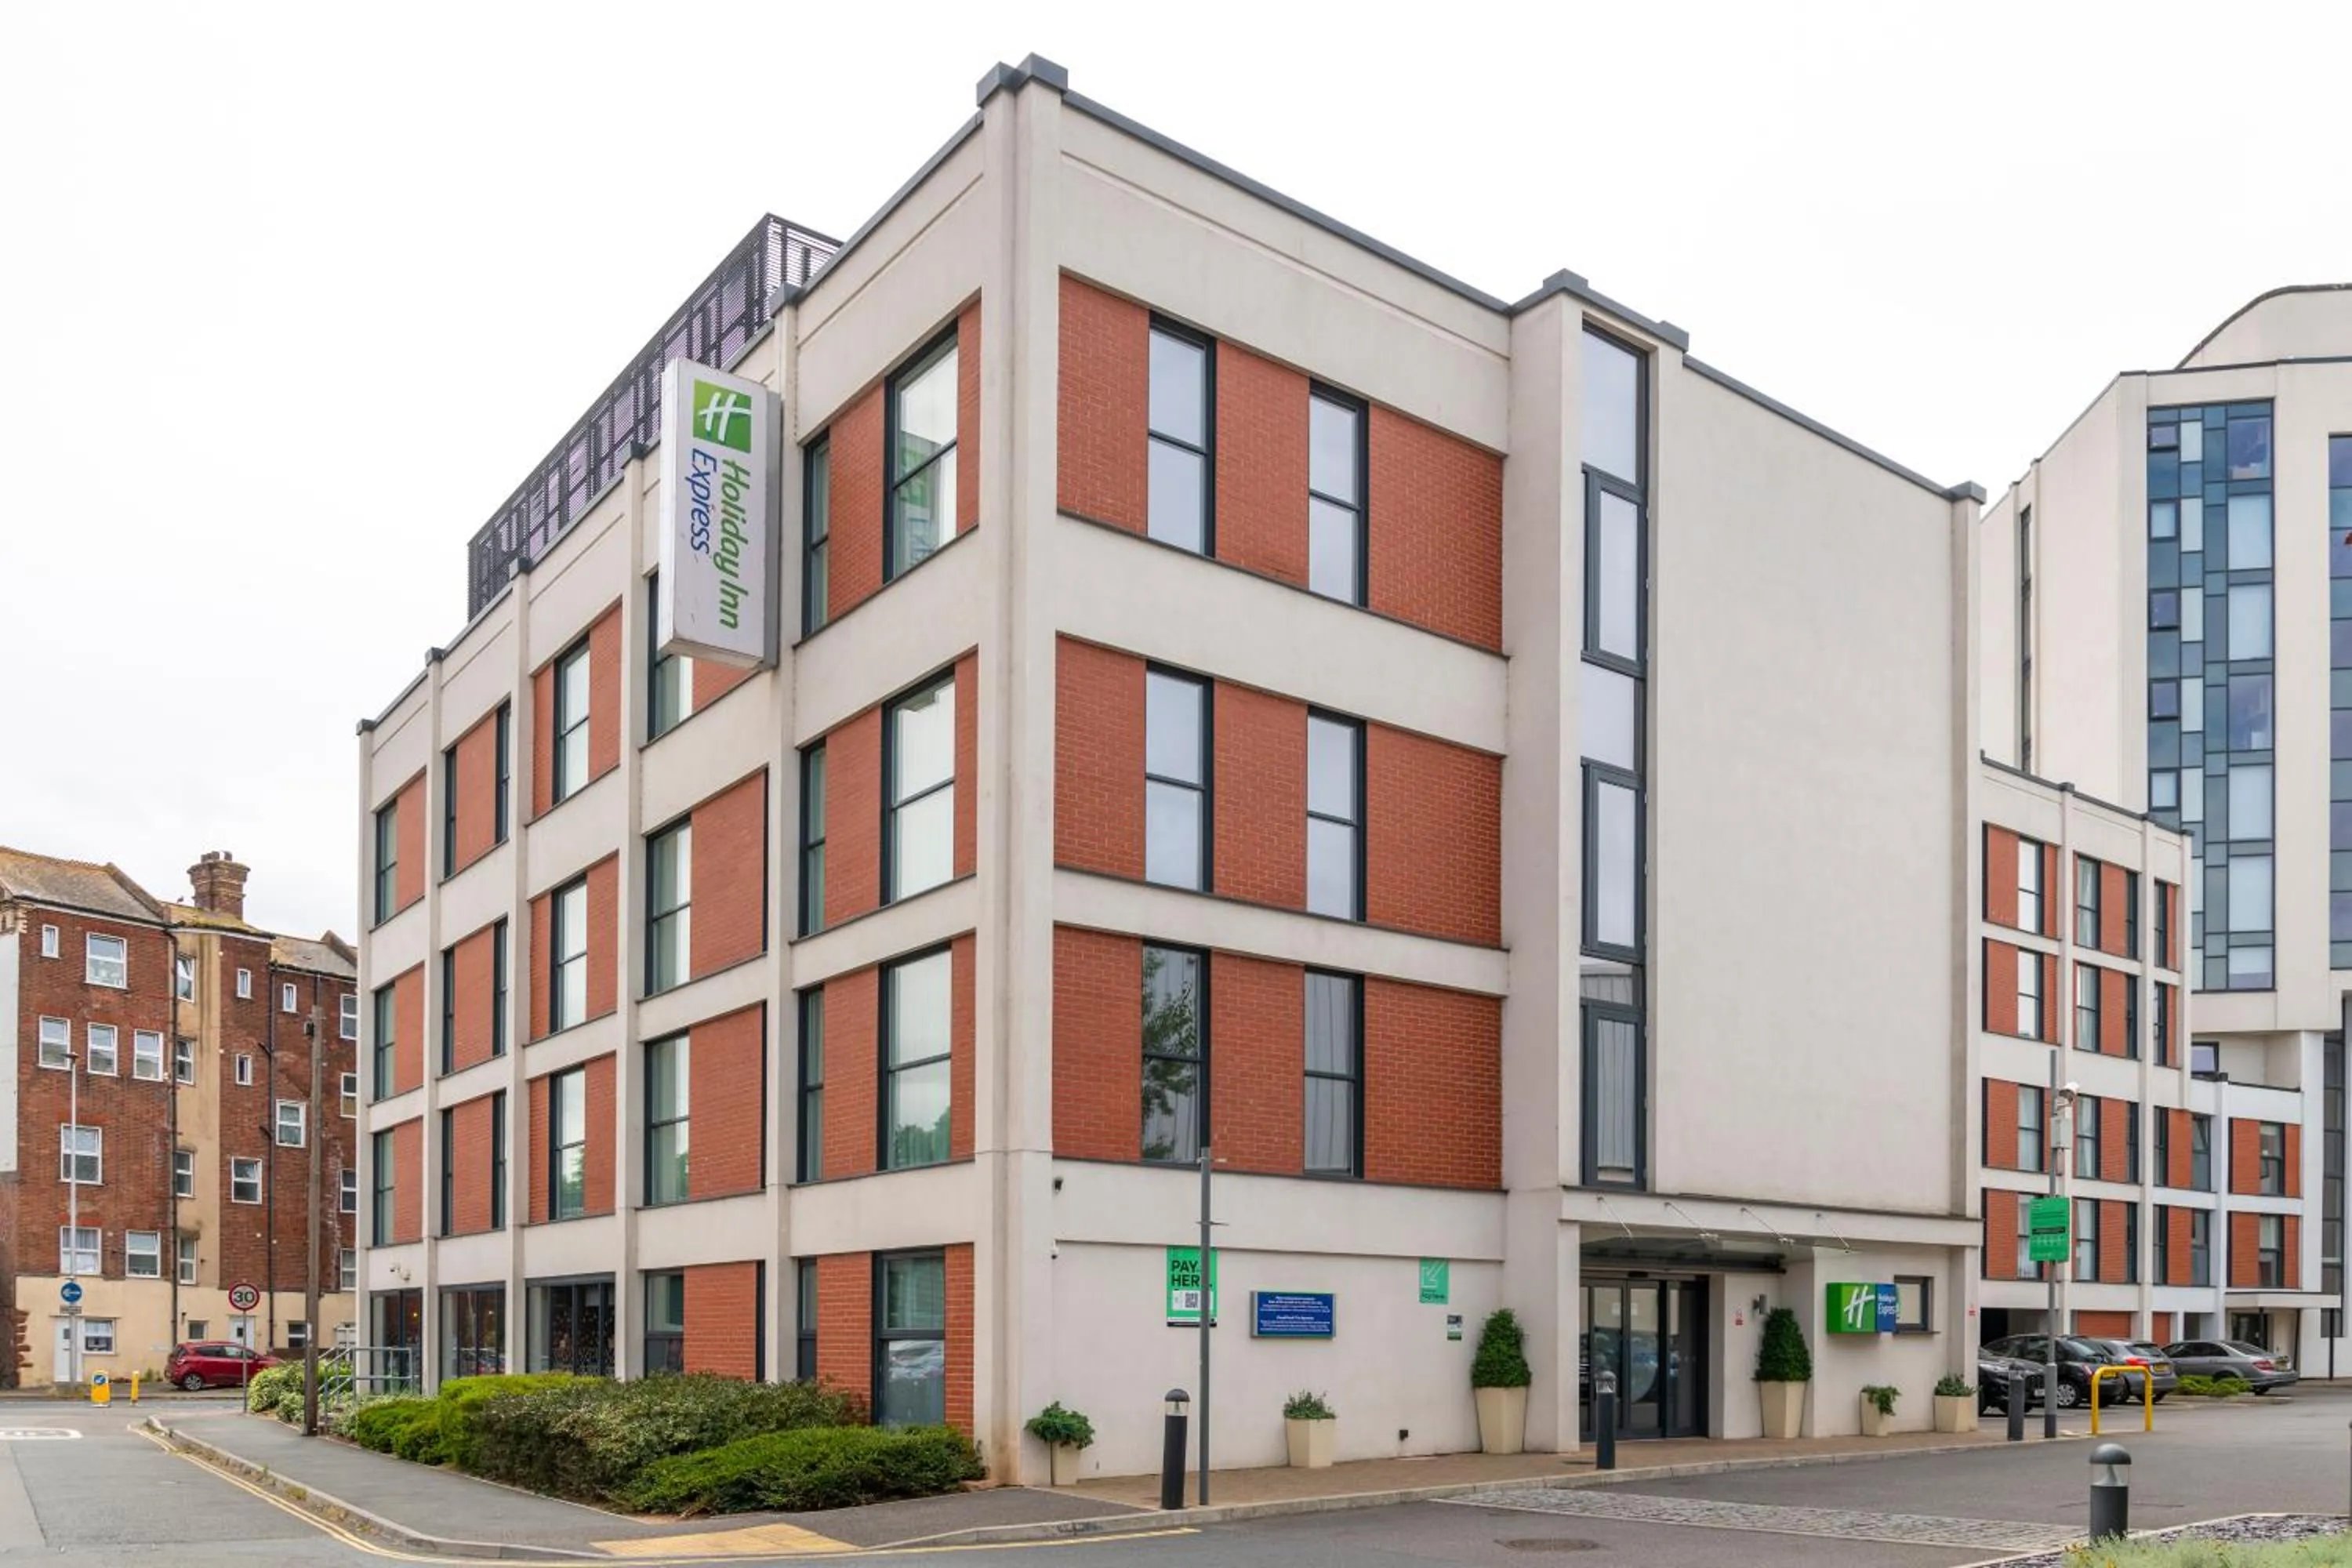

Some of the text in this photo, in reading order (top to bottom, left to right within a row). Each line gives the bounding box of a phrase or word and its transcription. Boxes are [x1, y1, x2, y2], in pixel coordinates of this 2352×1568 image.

[684, 448, 717, 554] Express
[713, 457, 750, 630] Holiday Inn
[1171, 1260, 1198, 1273] PAY
[233, 1290, 255, 1303] 30
